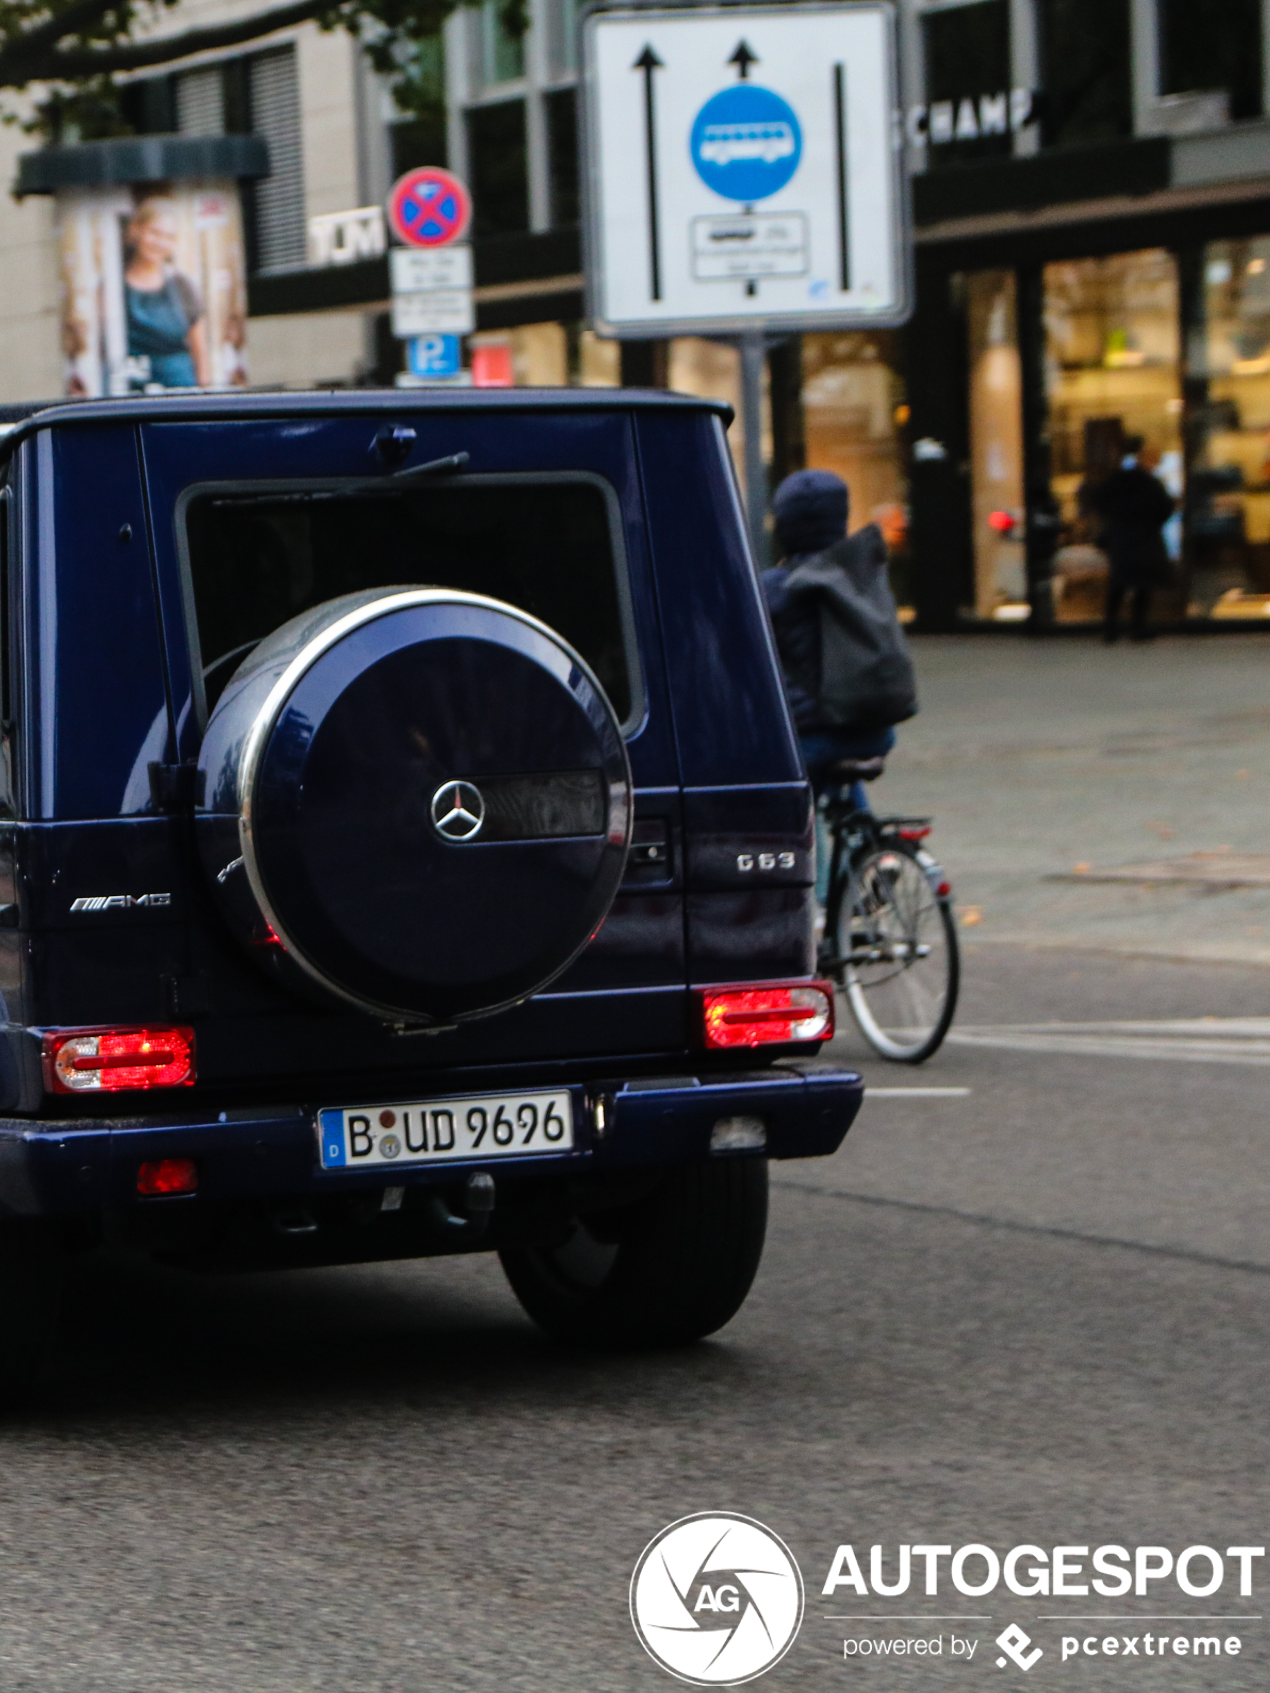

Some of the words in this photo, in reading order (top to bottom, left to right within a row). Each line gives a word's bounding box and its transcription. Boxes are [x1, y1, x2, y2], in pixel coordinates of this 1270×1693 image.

[102, 892, 172, 910] AMG
[466, 1100, 565, 1150] 9696
[329, 1144, 338, 1158] D
